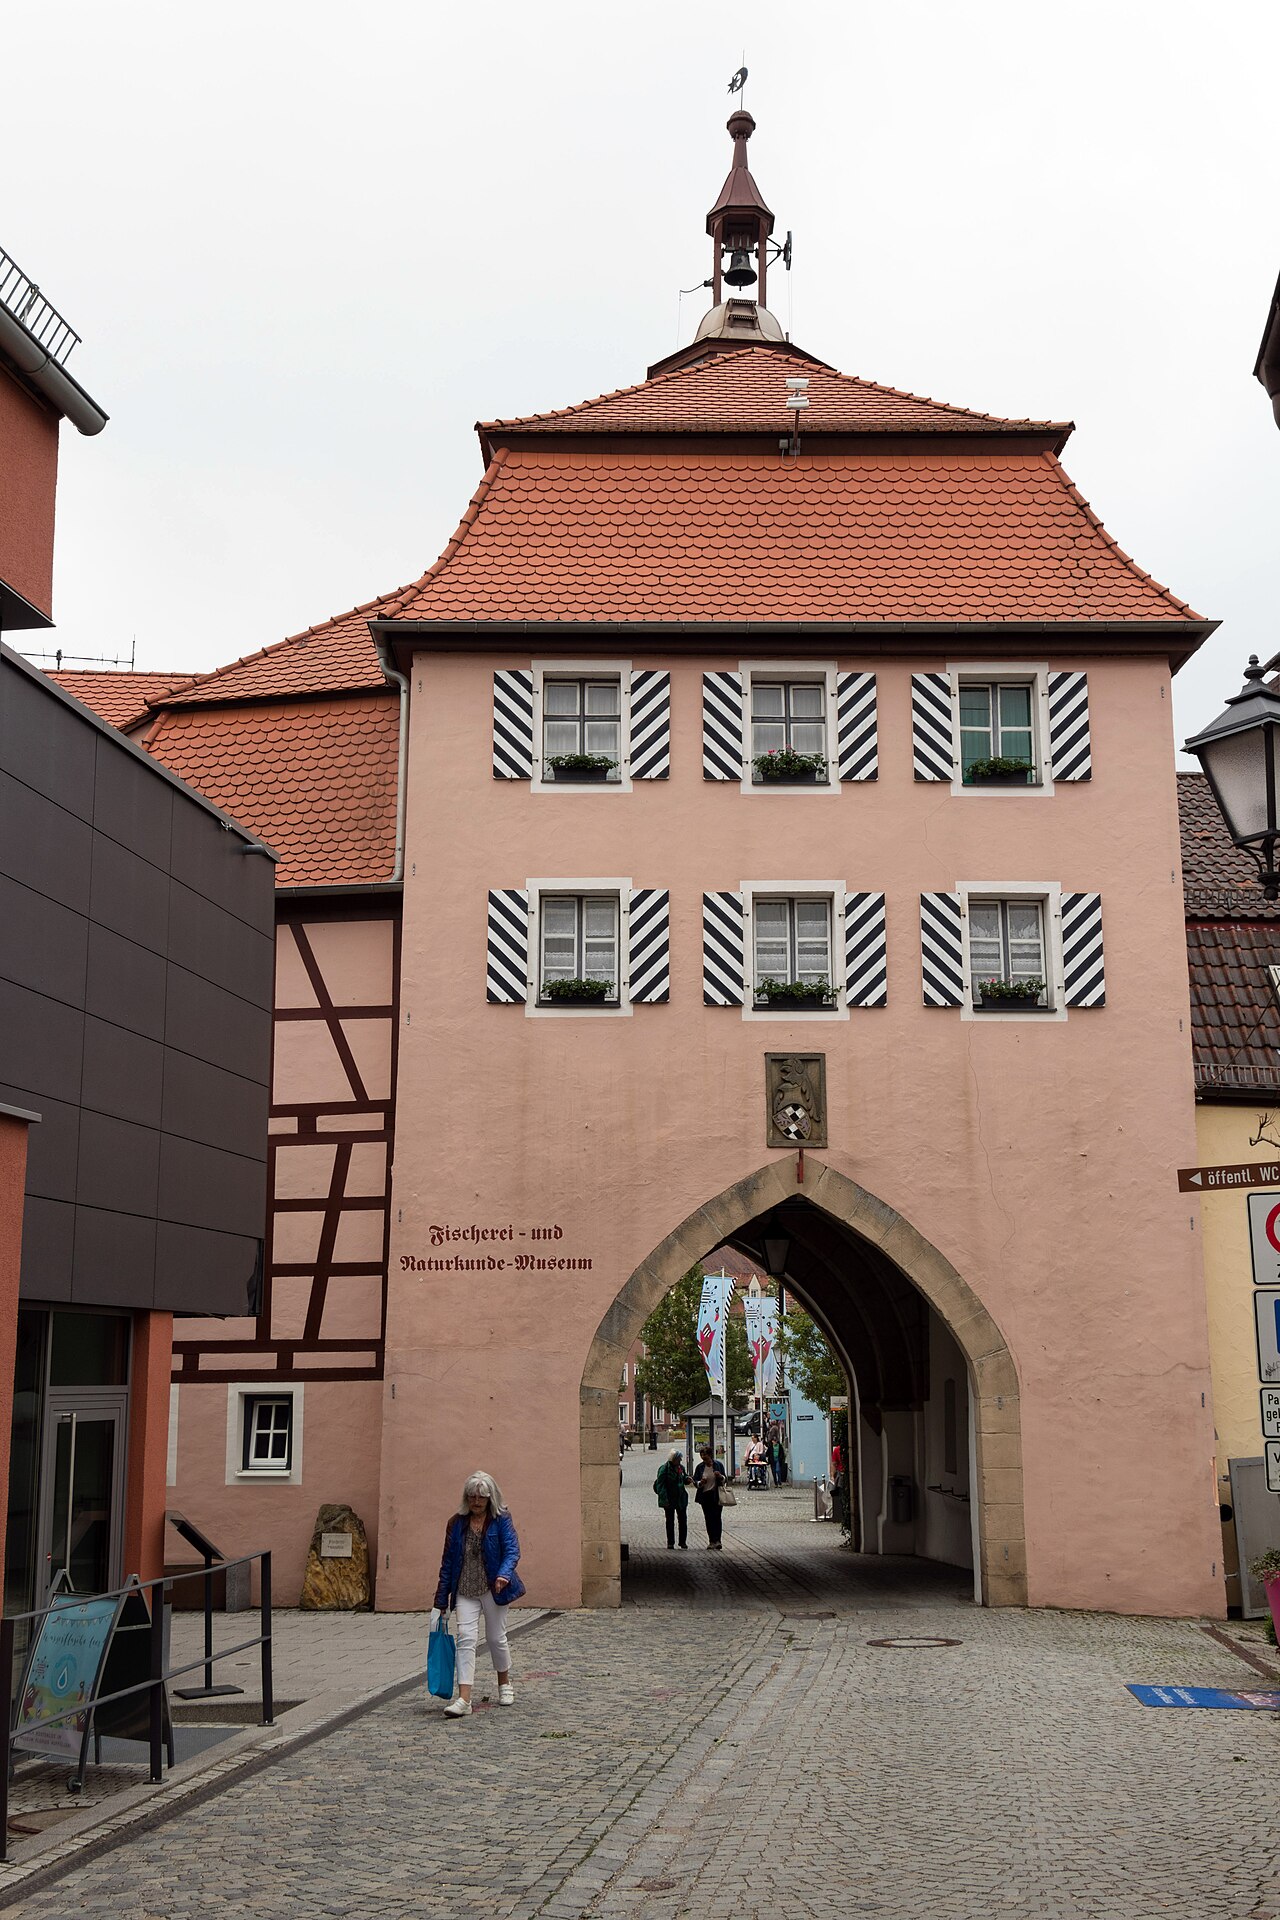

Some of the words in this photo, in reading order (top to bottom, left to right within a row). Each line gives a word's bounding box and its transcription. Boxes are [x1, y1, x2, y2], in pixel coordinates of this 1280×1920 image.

[1207, 1168, 1255, 1185] öffentl.
[1259, 1166, 1279, 1181] WC
[428, 1224, 514, 1247] Fischerei
[531, 1224, 563, 1240] und
[399, 1254, 593, 1271] Naturkunde-Museum
